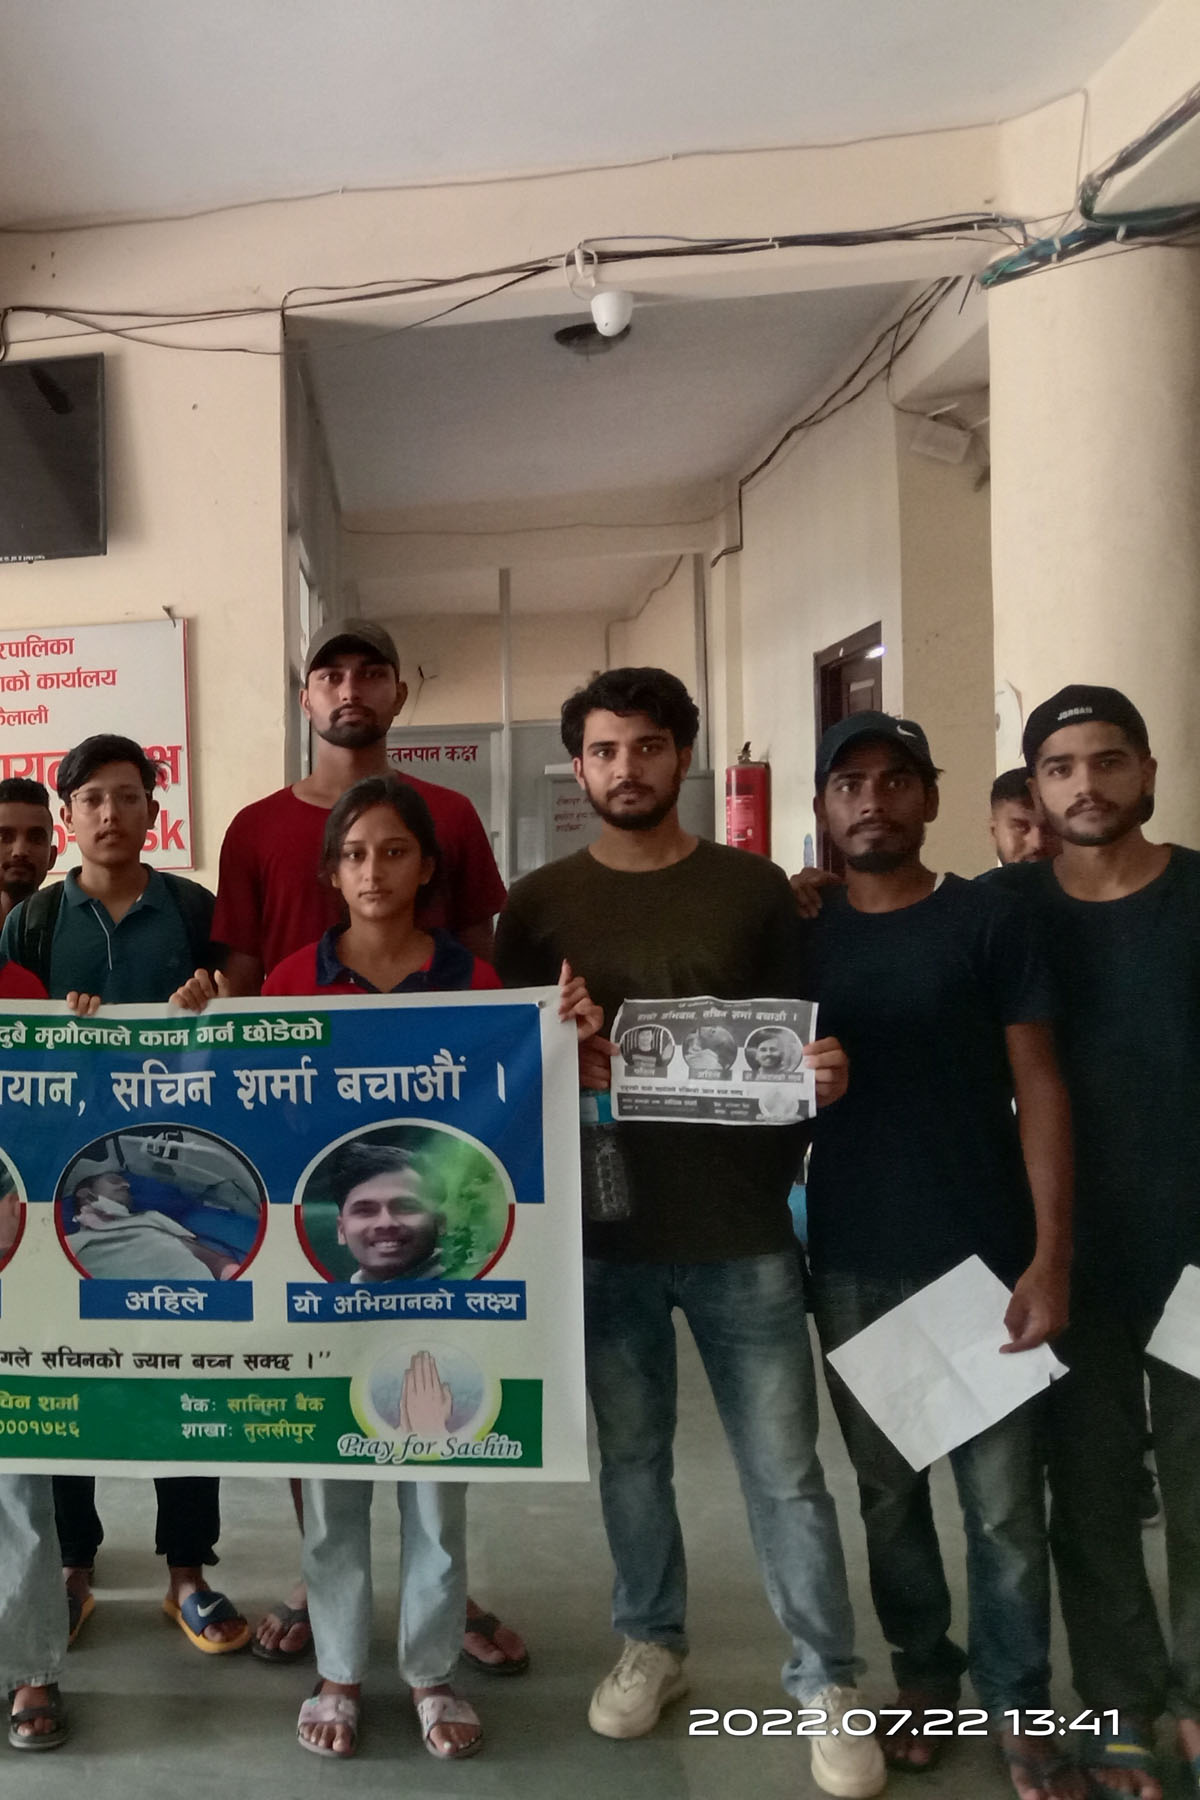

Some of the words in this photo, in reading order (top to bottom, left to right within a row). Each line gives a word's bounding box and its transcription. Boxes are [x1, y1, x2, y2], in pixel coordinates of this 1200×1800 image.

[36, 666, 118, 690] कार्यालय
[444, 745, 479, 762] कक्ष
[34, 1020, 132, 1049] मृगौलाले
[139, 1028, 190, 1046] काम
[196, 1022, 235, 1044] गर्न
[242, 1018, 323, 1042] छोडेको
[110, 1059, 216, 1112] सचिन
[233, 1055, 318, 1110] शर्मा
[334, 1048, 468, 1105] बचाऔं
[125, 1286, 208, 1313] अहिले
[292, 1290, 321, 1315] यो
[334, 1288, 455, 1315] अभियानको
[465, 1291, 522, 1314] लक्ष्य
[41, 1346, 124, 1369] सचिनको
[133, 1353, 182, 1370] ज्यान
[191, 1353, 234, 1370] बच्न
[243, 1353, 293, 1371] सक्छ
[38, 1393, 80, 1412] शर्मा
[243, 1419, 317, 1441] तुलसीपुर
[339, 1435, 403, 1463] Pray
[394, 1434, 438, 1463] for
[441, 1433, 522, 1458] Sachin
